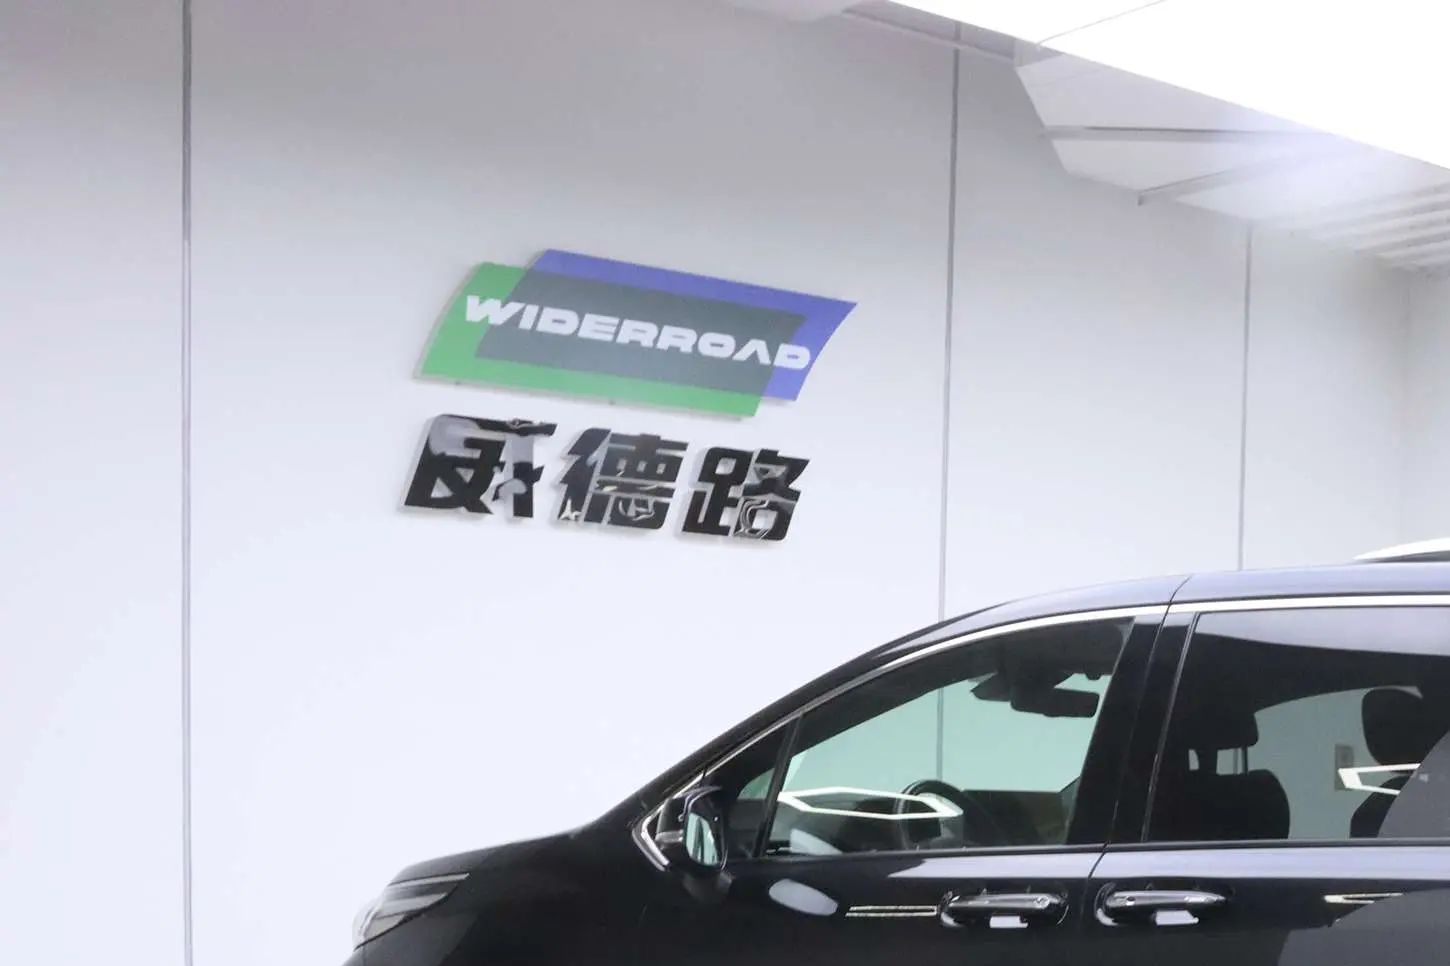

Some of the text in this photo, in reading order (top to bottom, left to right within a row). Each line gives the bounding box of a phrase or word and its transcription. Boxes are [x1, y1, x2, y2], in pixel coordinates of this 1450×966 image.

[464, 294, 812, 371] WIDERROAD
[403, 413, 811, 541] 威德路
